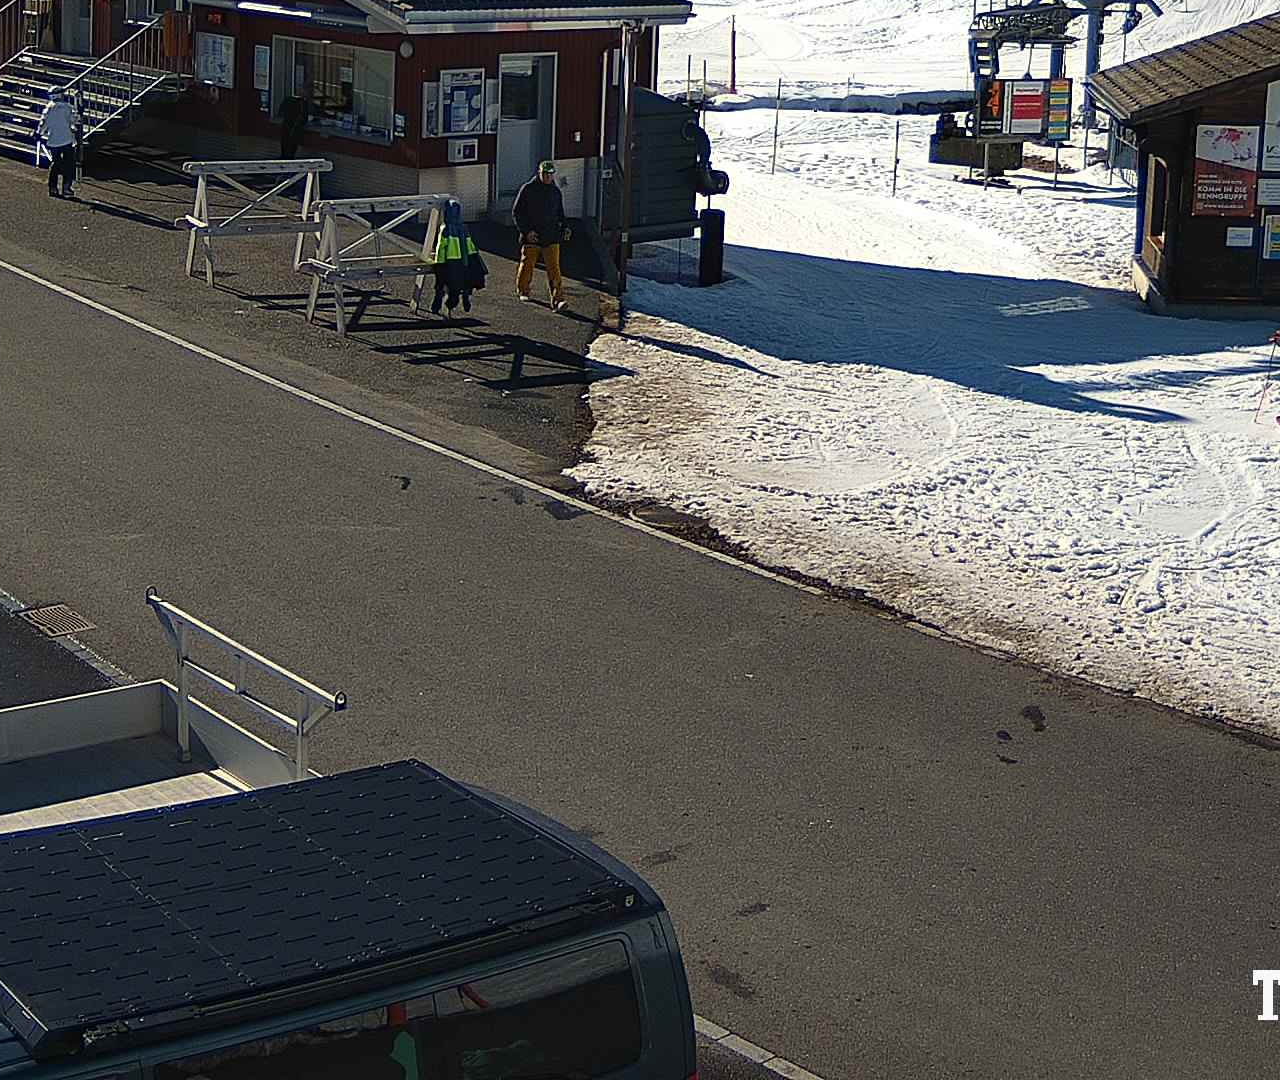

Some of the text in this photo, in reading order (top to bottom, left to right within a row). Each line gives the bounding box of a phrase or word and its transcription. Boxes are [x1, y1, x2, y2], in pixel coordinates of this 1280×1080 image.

[1197, 185, 1222, 193] KOMM
[1234, 186, 1248, 194] DIE
[1197, 193, 1249, 201] RENNGRUPPE
